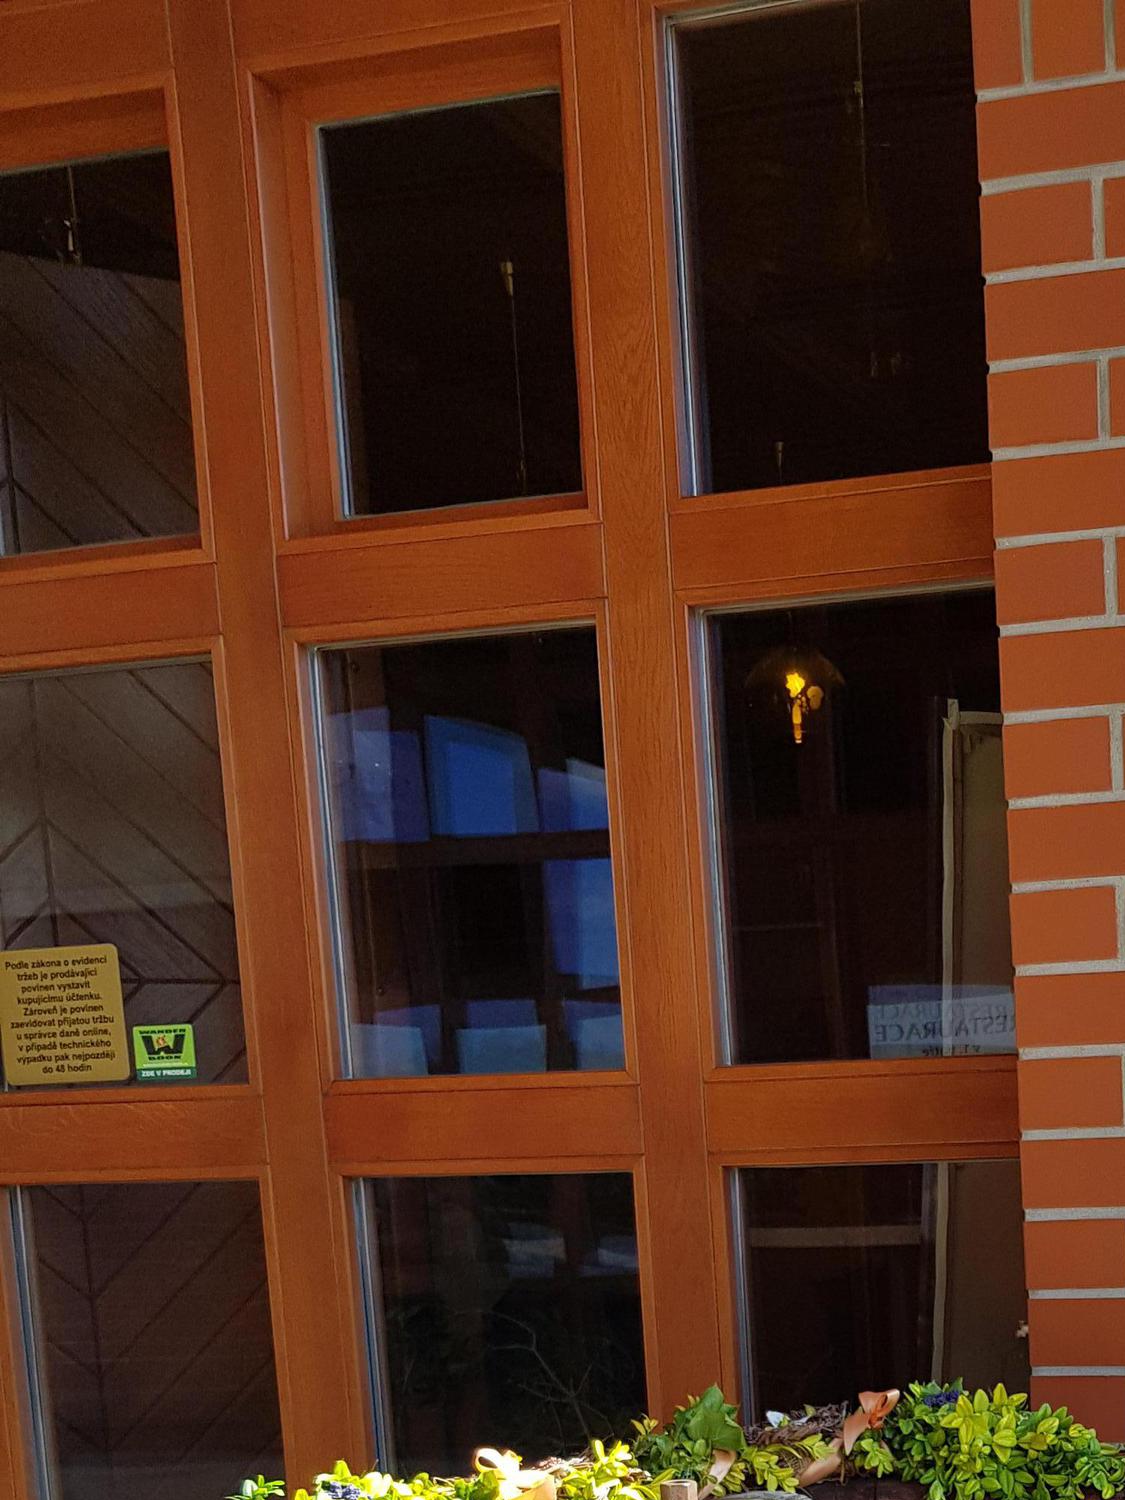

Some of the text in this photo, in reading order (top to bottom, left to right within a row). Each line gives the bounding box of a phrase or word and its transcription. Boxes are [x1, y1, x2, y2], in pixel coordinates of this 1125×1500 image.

[5, 961, 29, 970] Podle
[31, 958, 61, 968] zákona
[71, 956, 107, 966] evidenci
[17, 968, 97, 982] tržeb je prodávající
[21, 980, 90, 994] povinen vystavit
[17, 992, 102, 1006] kupujícímu účtenku.
[23, 1004, 104, 1016] Zároveň je povinen
[10, 1015, 114, 1029] zaevidovat přijatou tržbu
[24, 1030, 57, 1042] správce
[59, 1028, 80, 1038] daně
[25, 1041, 57, 1053] případě
[59, 1039, 111, 1050] technického
[16, 1050, 116, 1065] výpadku pak nejpozději
[42, 1063, 92, 1074] do 48 hodin
